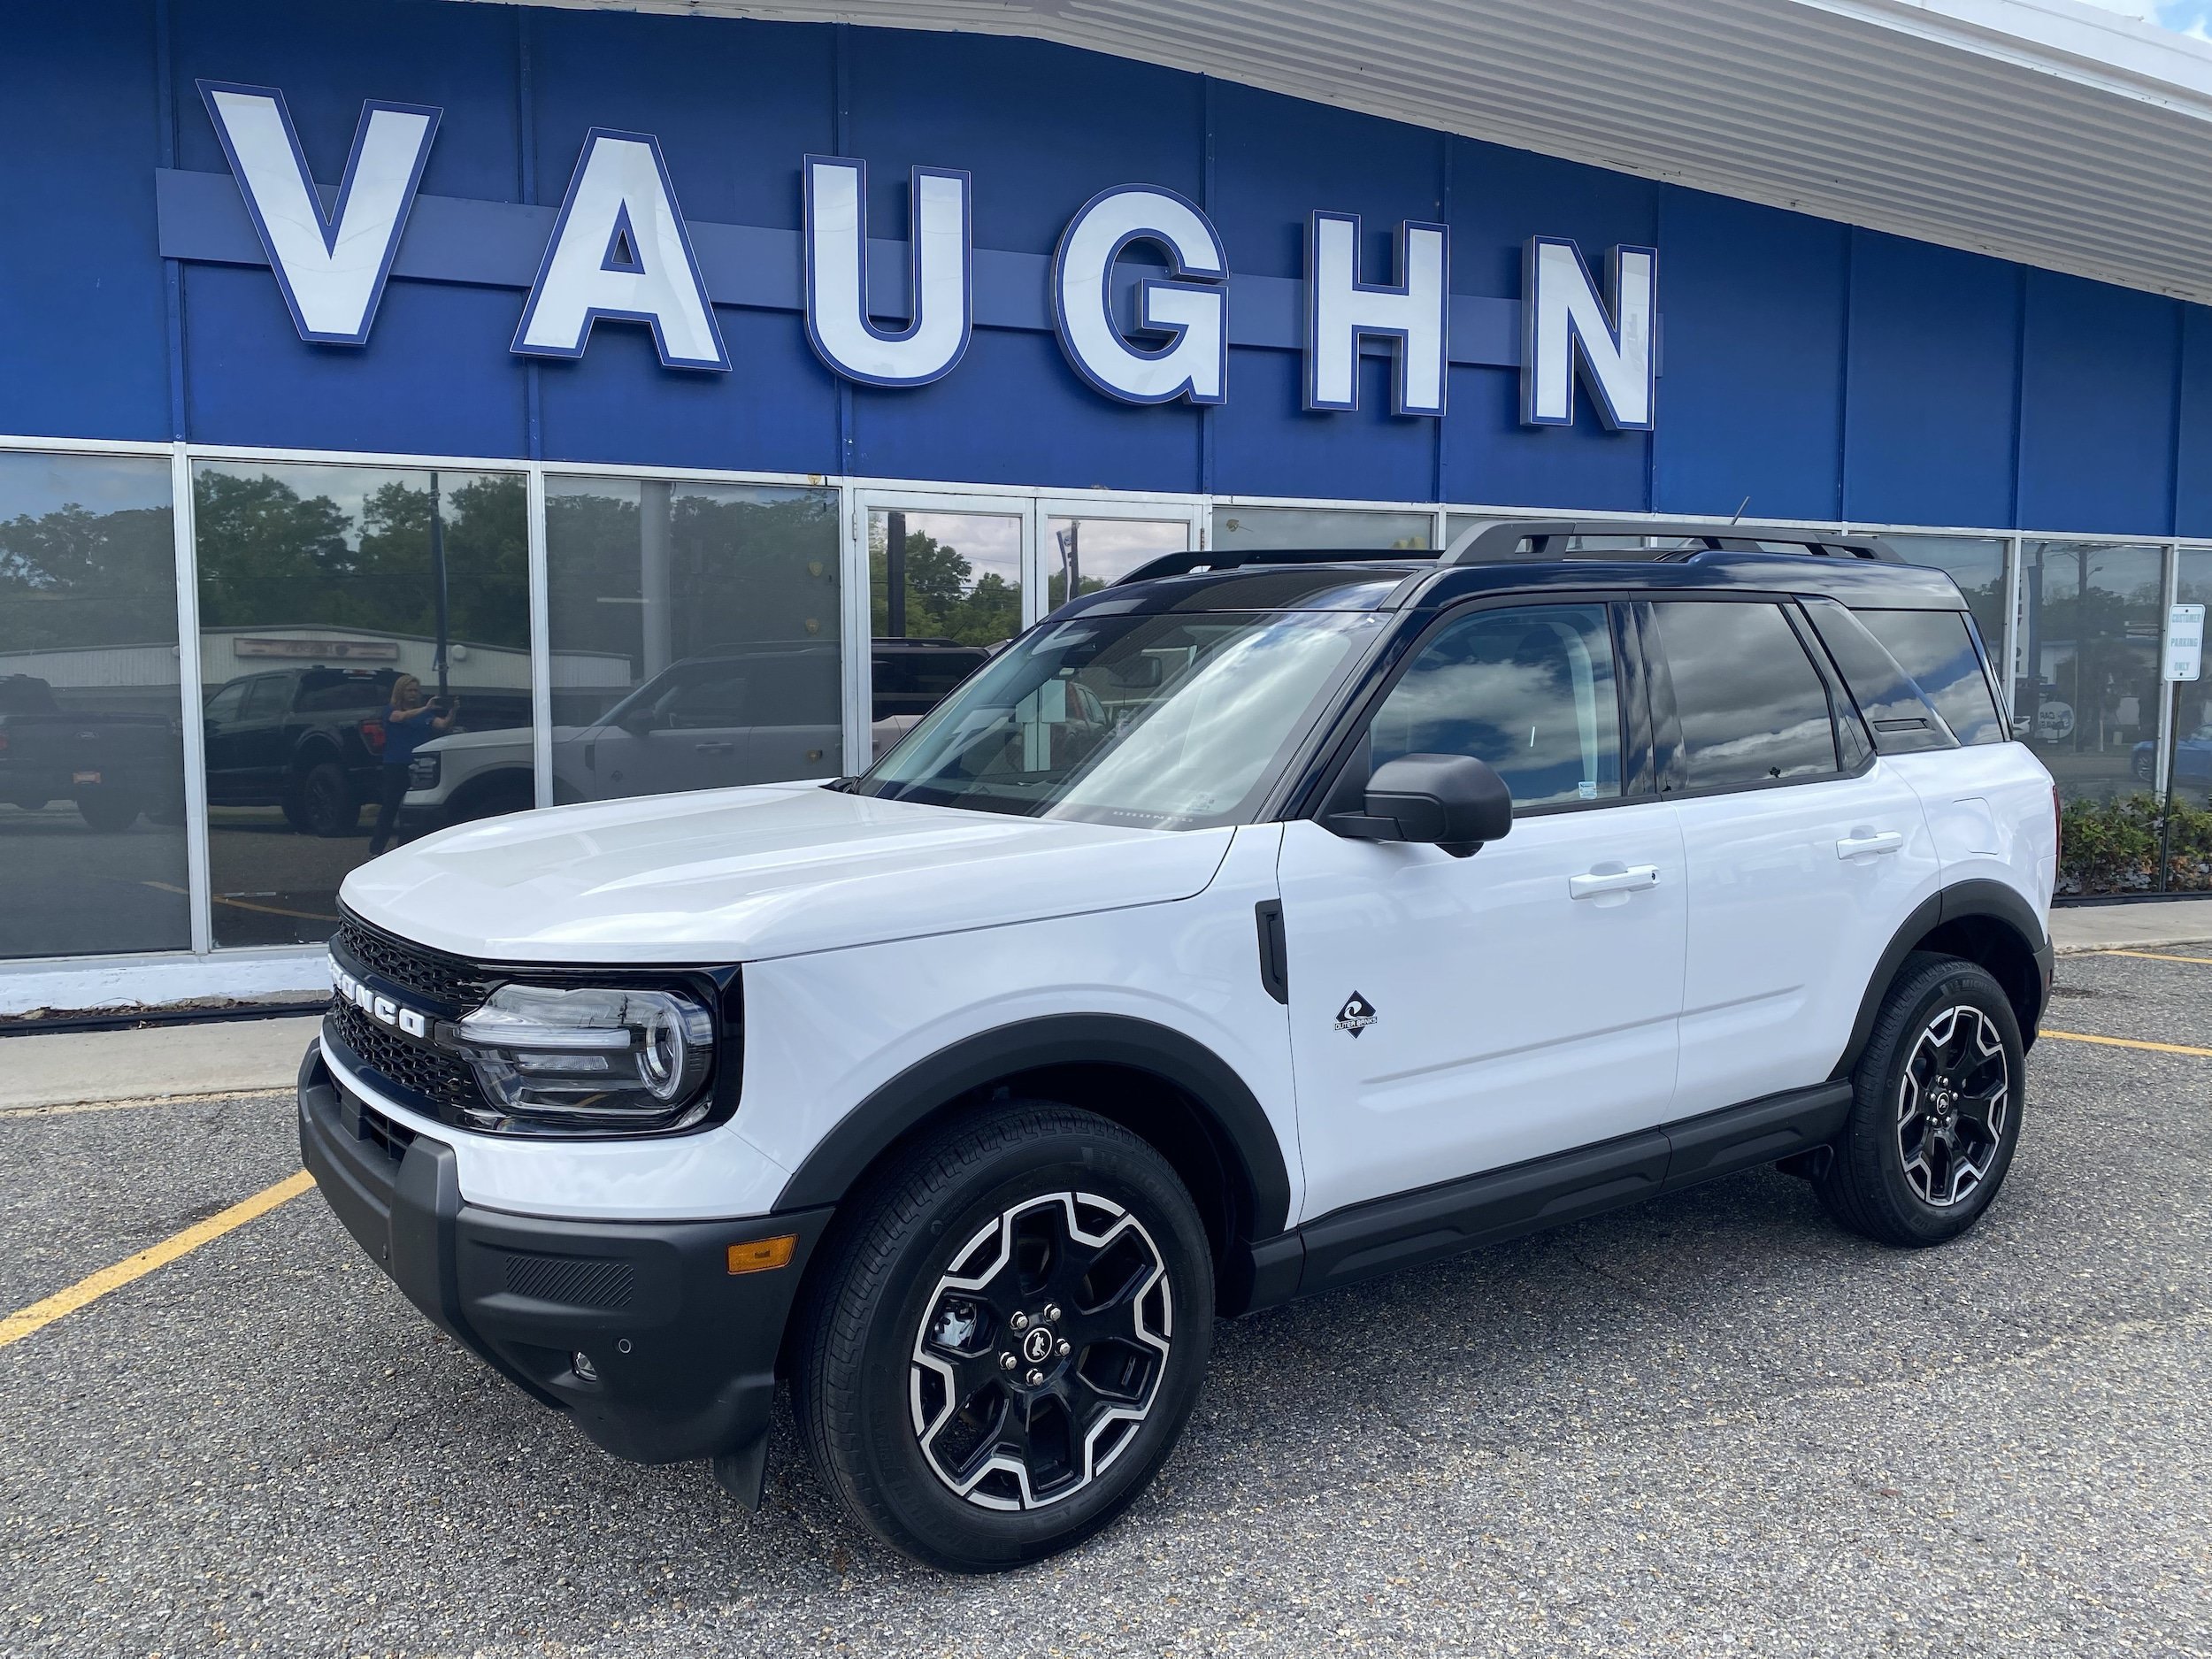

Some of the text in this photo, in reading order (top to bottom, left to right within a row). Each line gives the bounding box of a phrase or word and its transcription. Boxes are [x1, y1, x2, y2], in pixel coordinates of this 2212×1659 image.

[195, 78, 1658, 433] VAUGHN
[2171, 613, 2201, 624] CUSTOMER
[2170, 637, 2199, 648] PARKING
[2174, 661, 2191, 672] ONLY
[1335, 1016, 1378, 1031] OUTER BANKS
